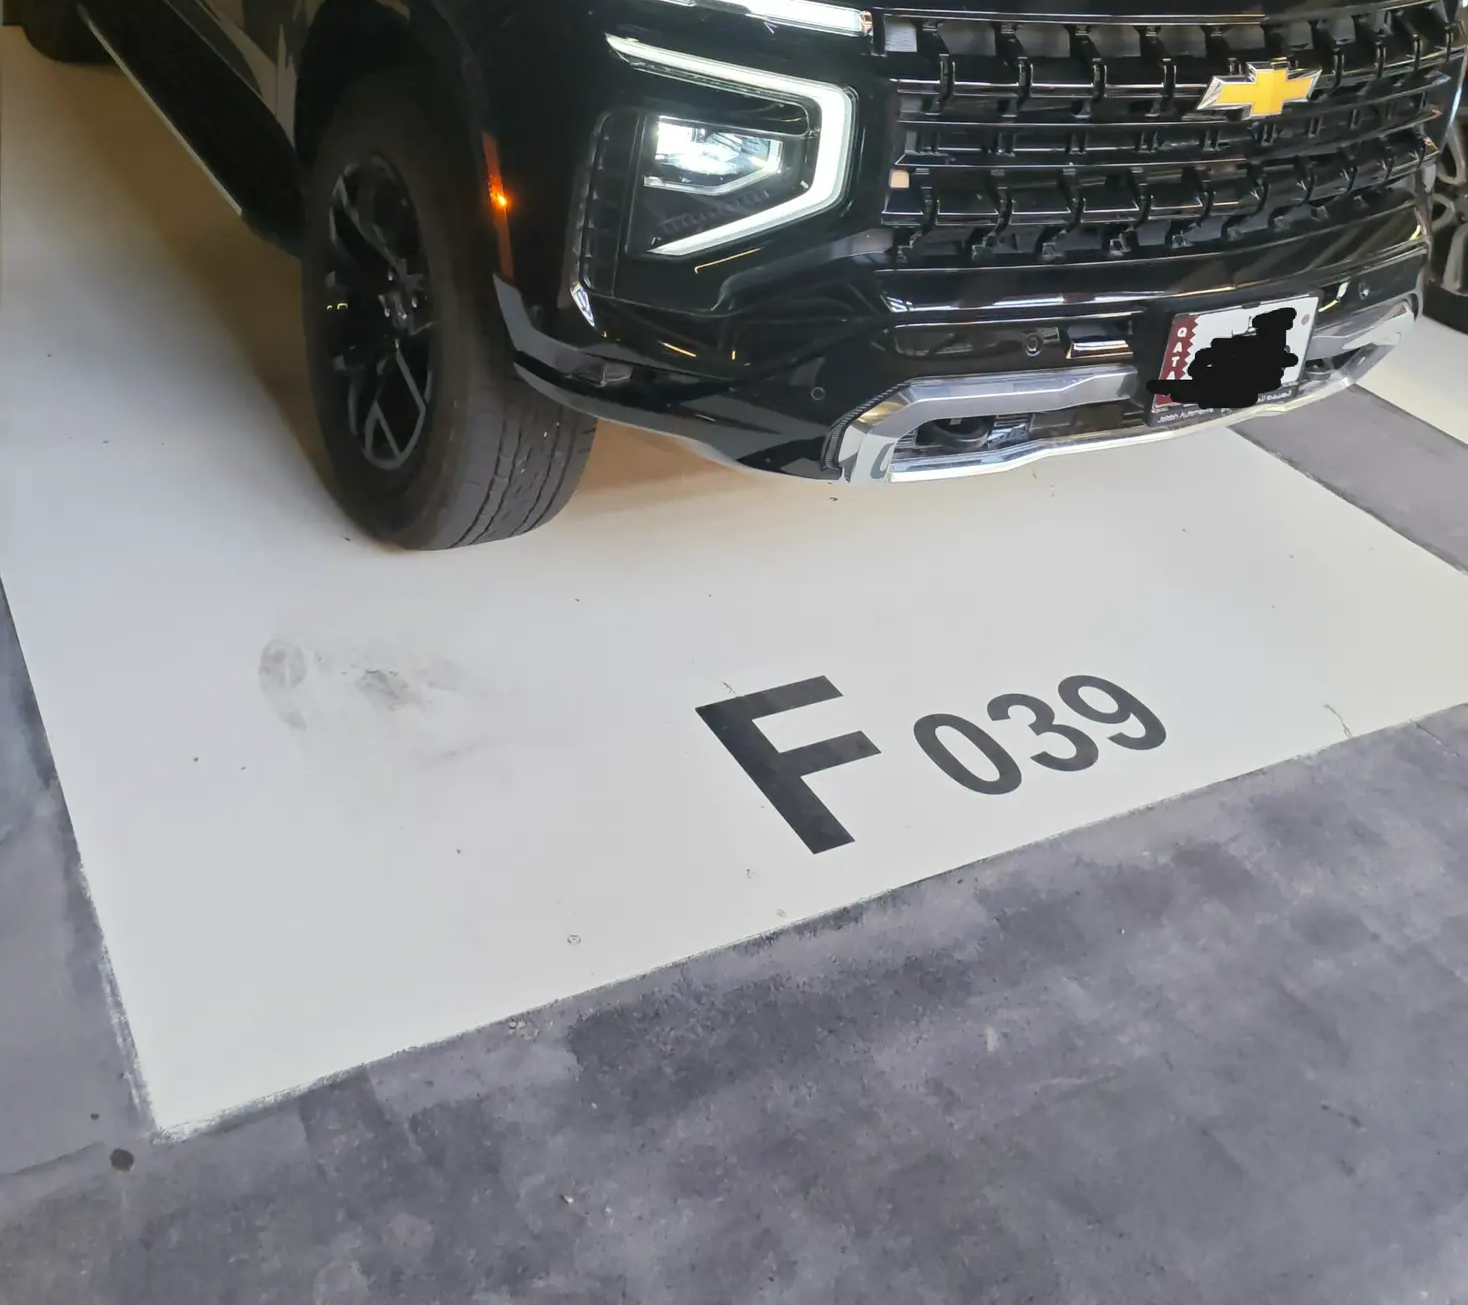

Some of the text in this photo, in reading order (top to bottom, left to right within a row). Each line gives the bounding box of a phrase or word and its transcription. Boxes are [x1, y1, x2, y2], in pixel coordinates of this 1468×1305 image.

[1166, 326, 1188, 380] QATA
[695, 674, 1167, 855] F 039
